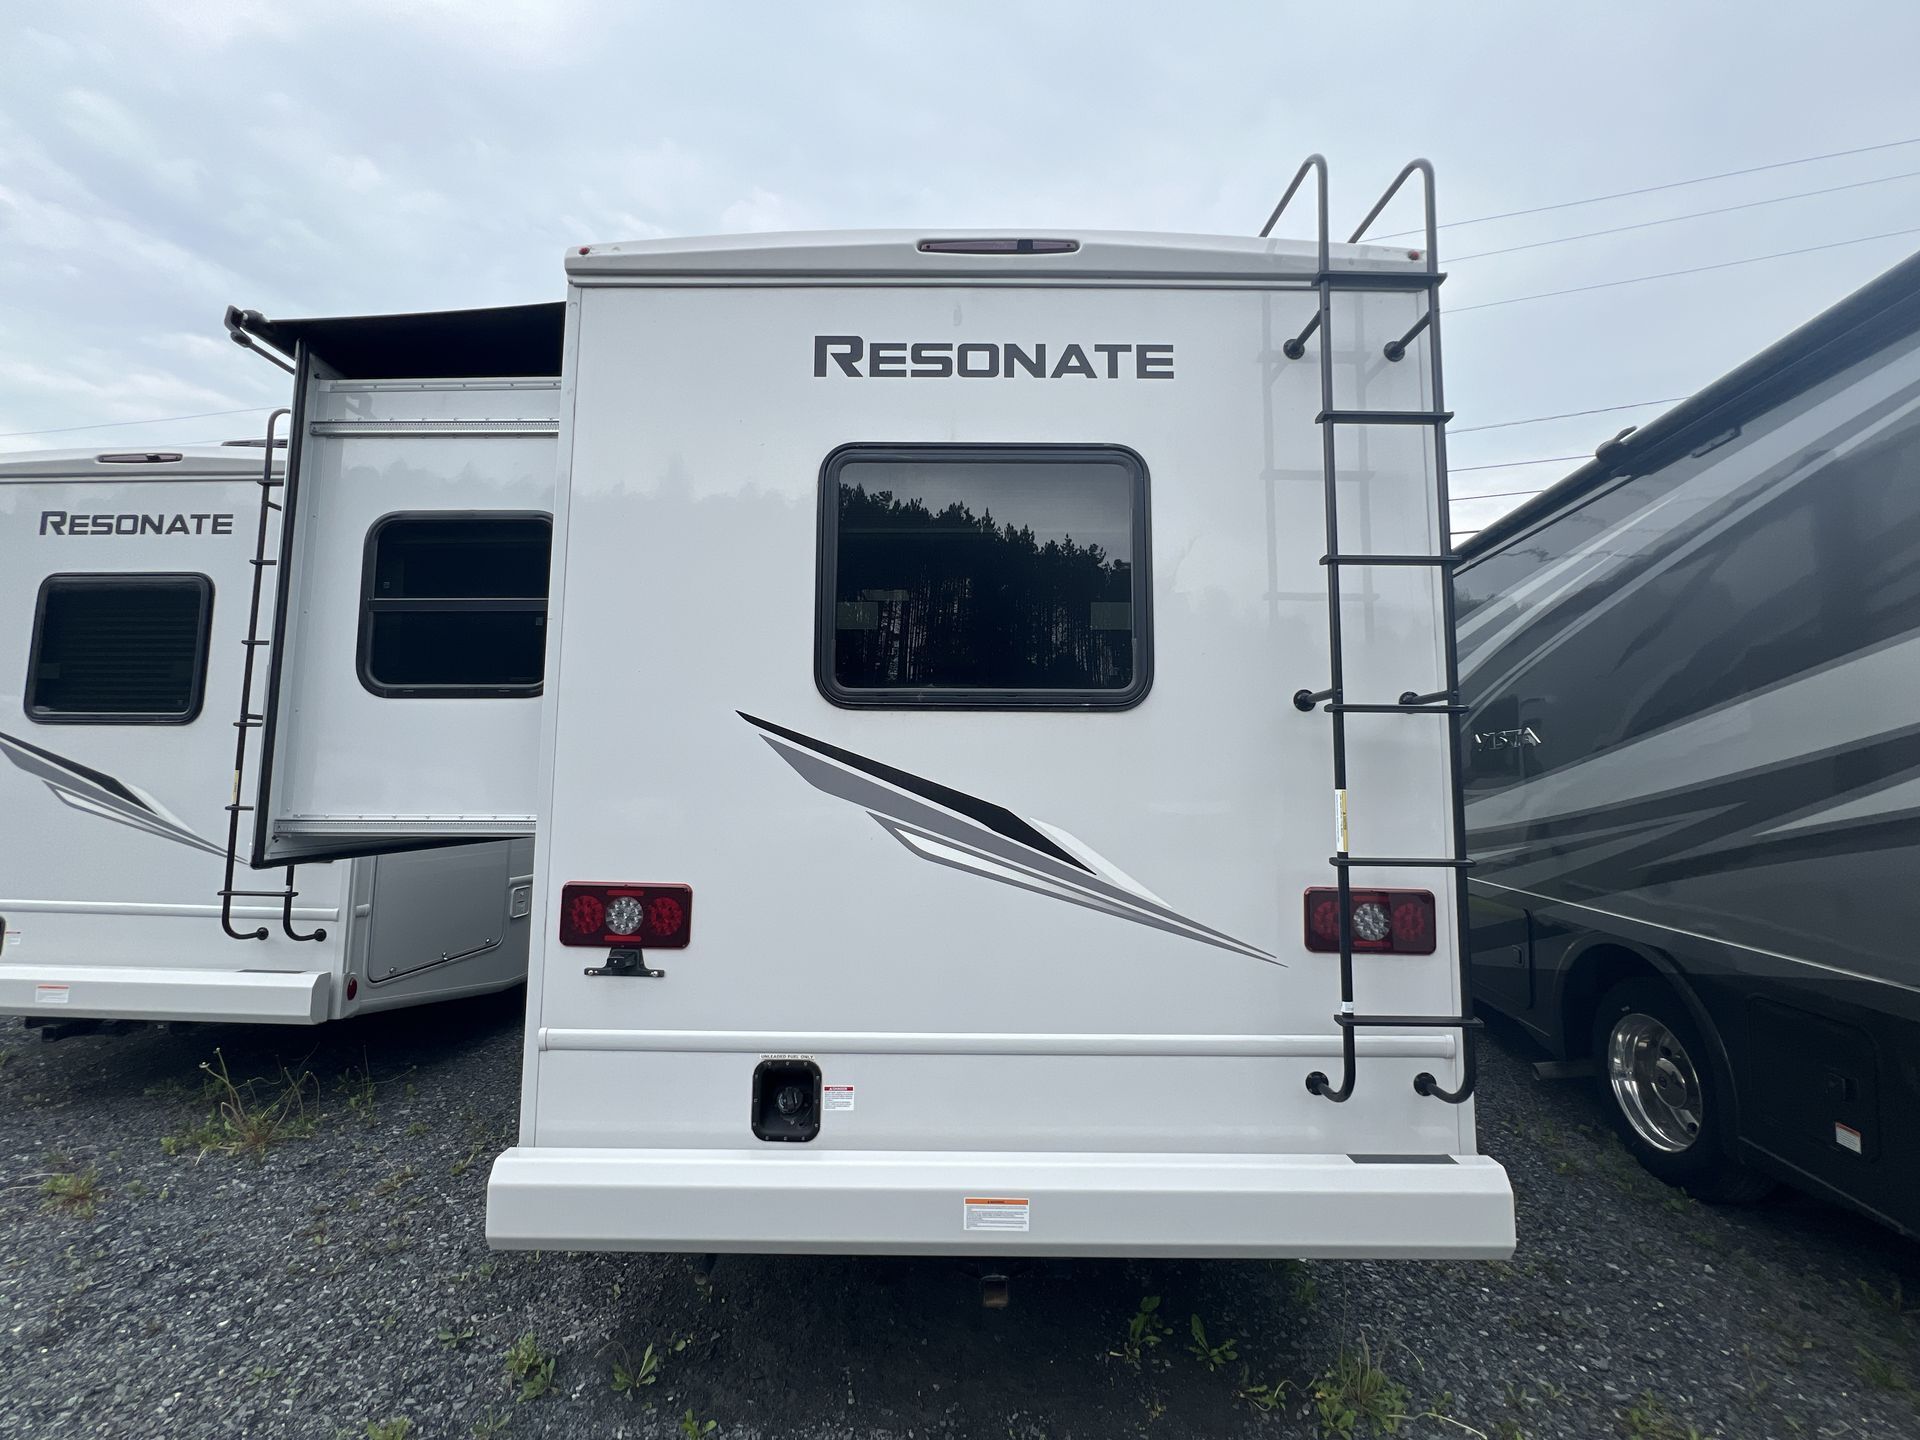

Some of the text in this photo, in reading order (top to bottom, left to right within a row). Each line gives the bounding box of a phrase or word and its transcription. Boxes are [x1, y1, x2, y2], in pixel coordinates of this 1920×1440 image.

[814, 335, 1174, 379] RESONATE
[40, 510, 234, 536] RESONATE
[1475, 727, 1541, 751] VISTA
